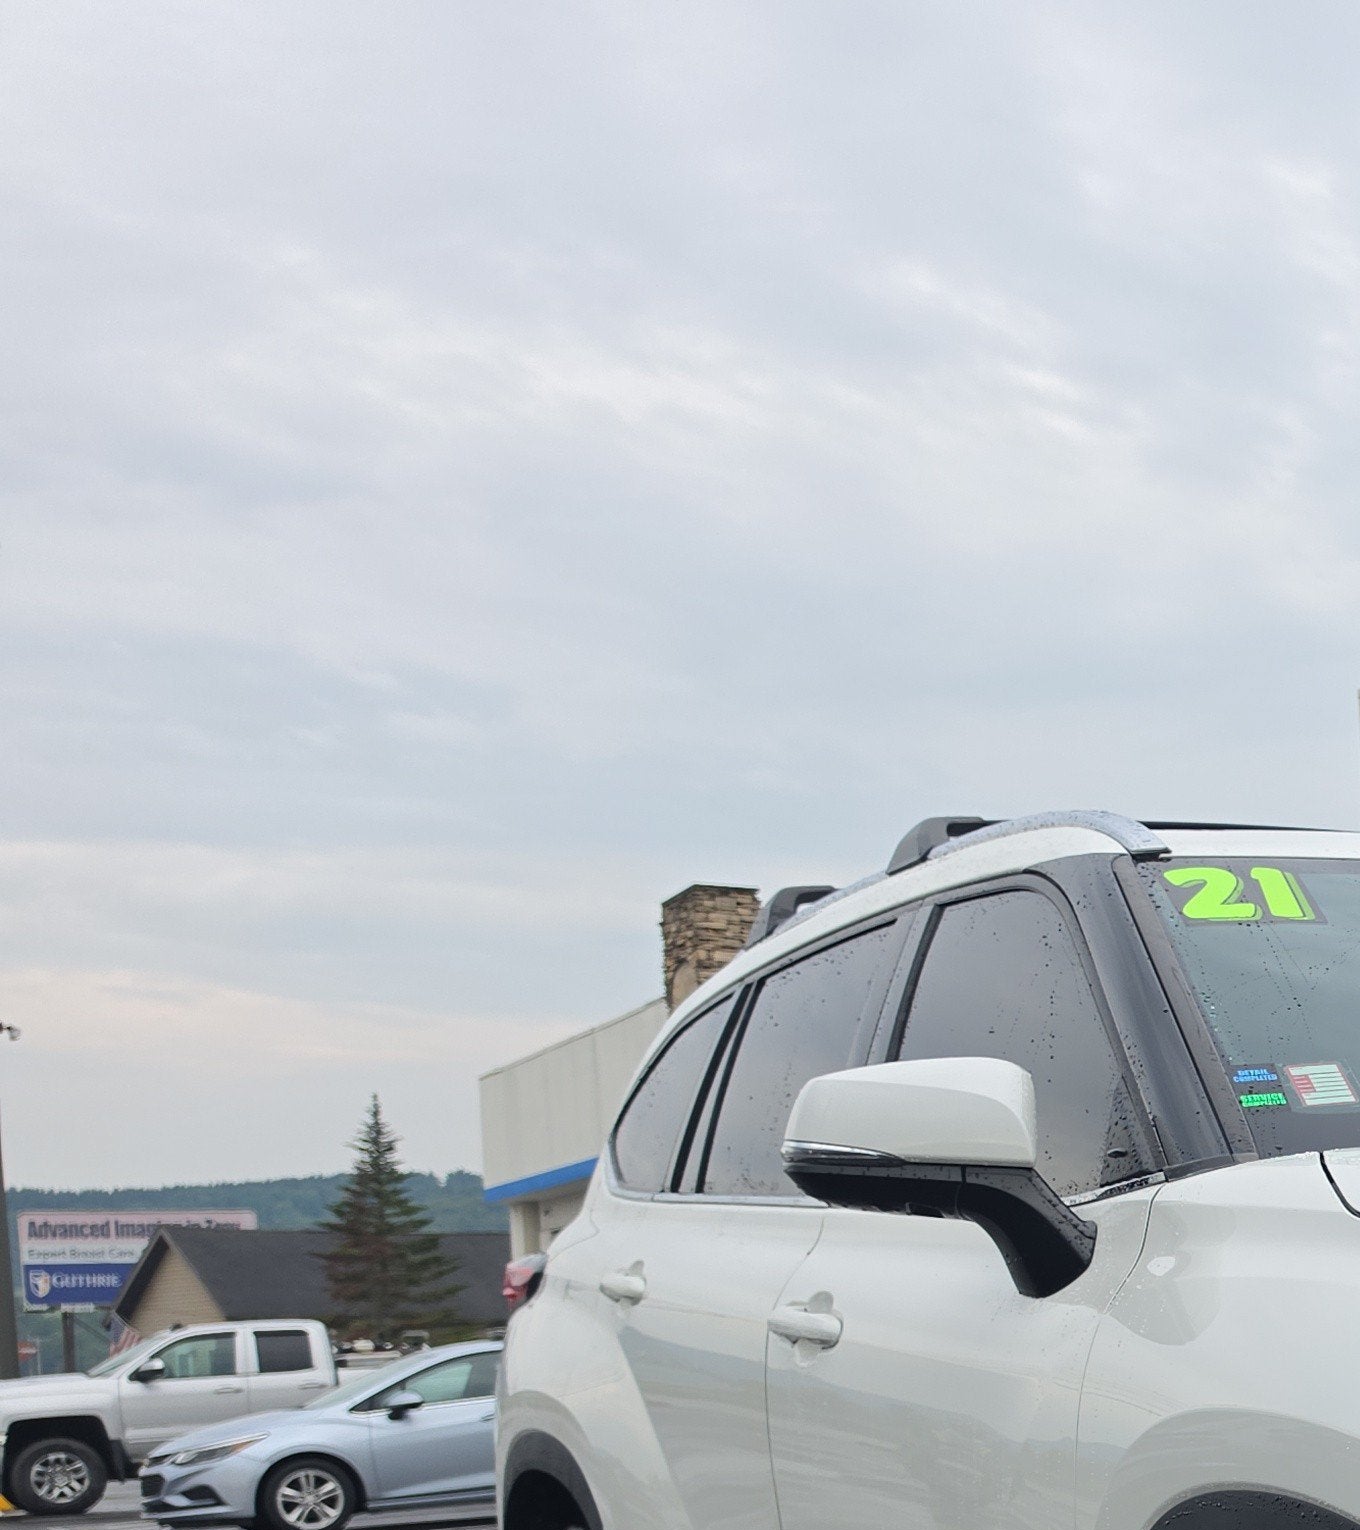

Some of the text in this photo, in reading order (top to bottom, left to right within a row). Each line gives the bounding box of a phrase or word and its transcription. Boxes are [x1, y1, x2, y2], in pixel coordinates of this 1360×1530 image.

[1163, 867, 1314, 920] 21
[1240, 1093, 1284, 1102] SERVICE
[27, 1220, 110, 1239] Advanced
